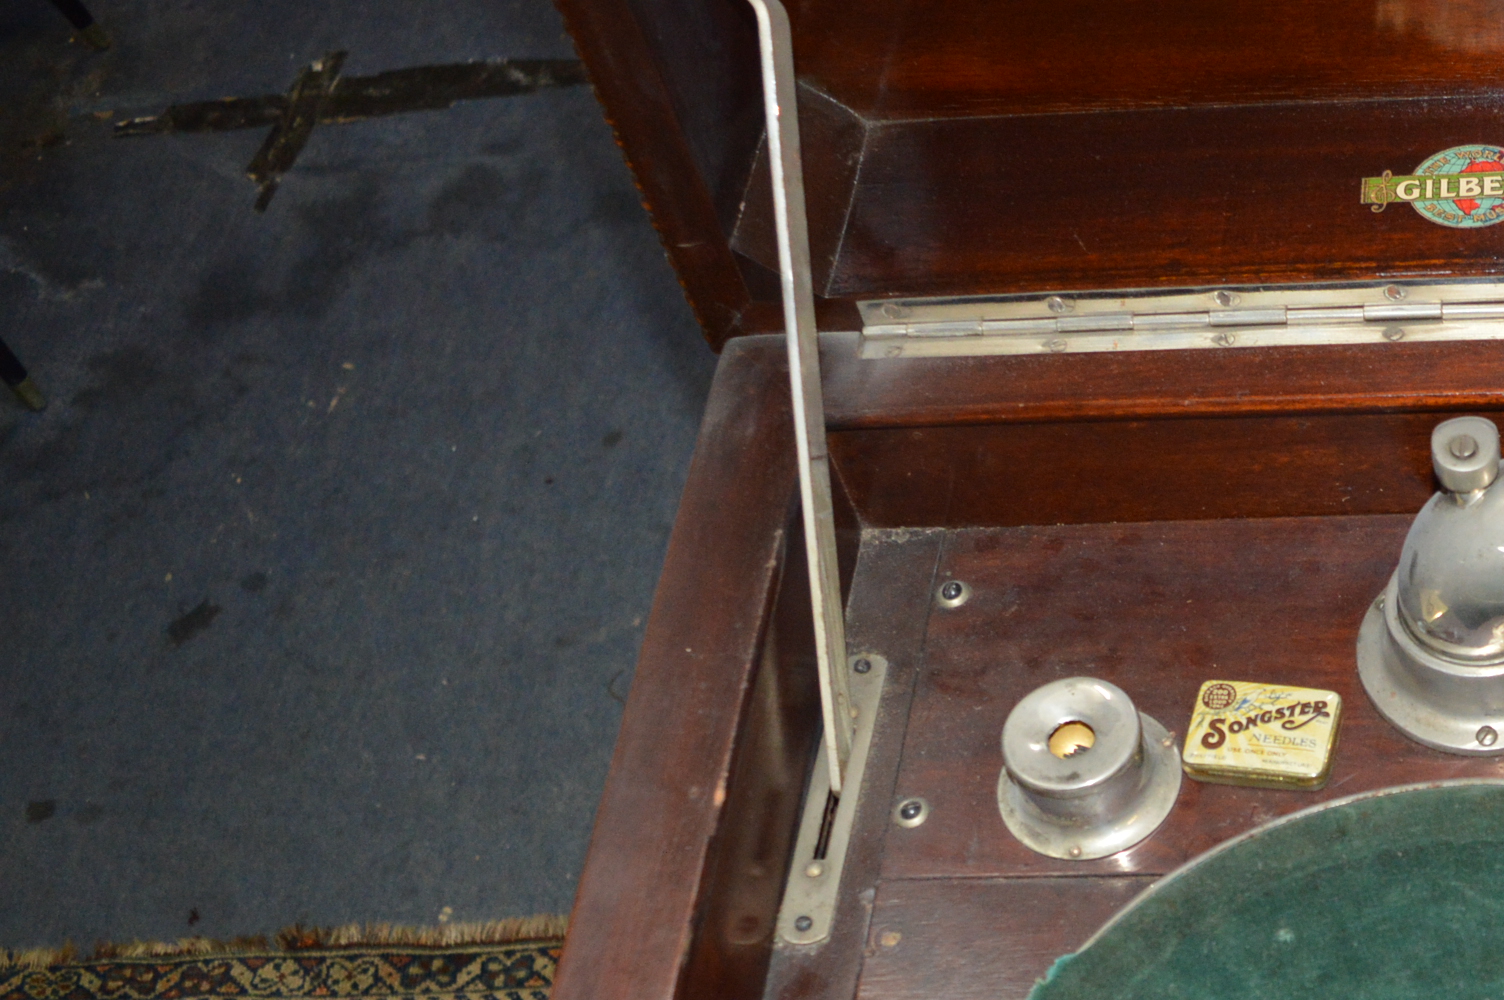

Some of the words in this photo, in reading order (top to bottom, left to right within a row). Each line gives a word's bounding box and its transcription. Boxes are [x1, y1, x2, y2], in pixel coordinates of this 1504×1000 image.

[1423, 156, 1450, 175] THE
[1424, 204, 1466, 221] BEST
[1201, 700, 1331, 750] SONGSTER
[1250, 733, 1317, 748] NEEDLES
